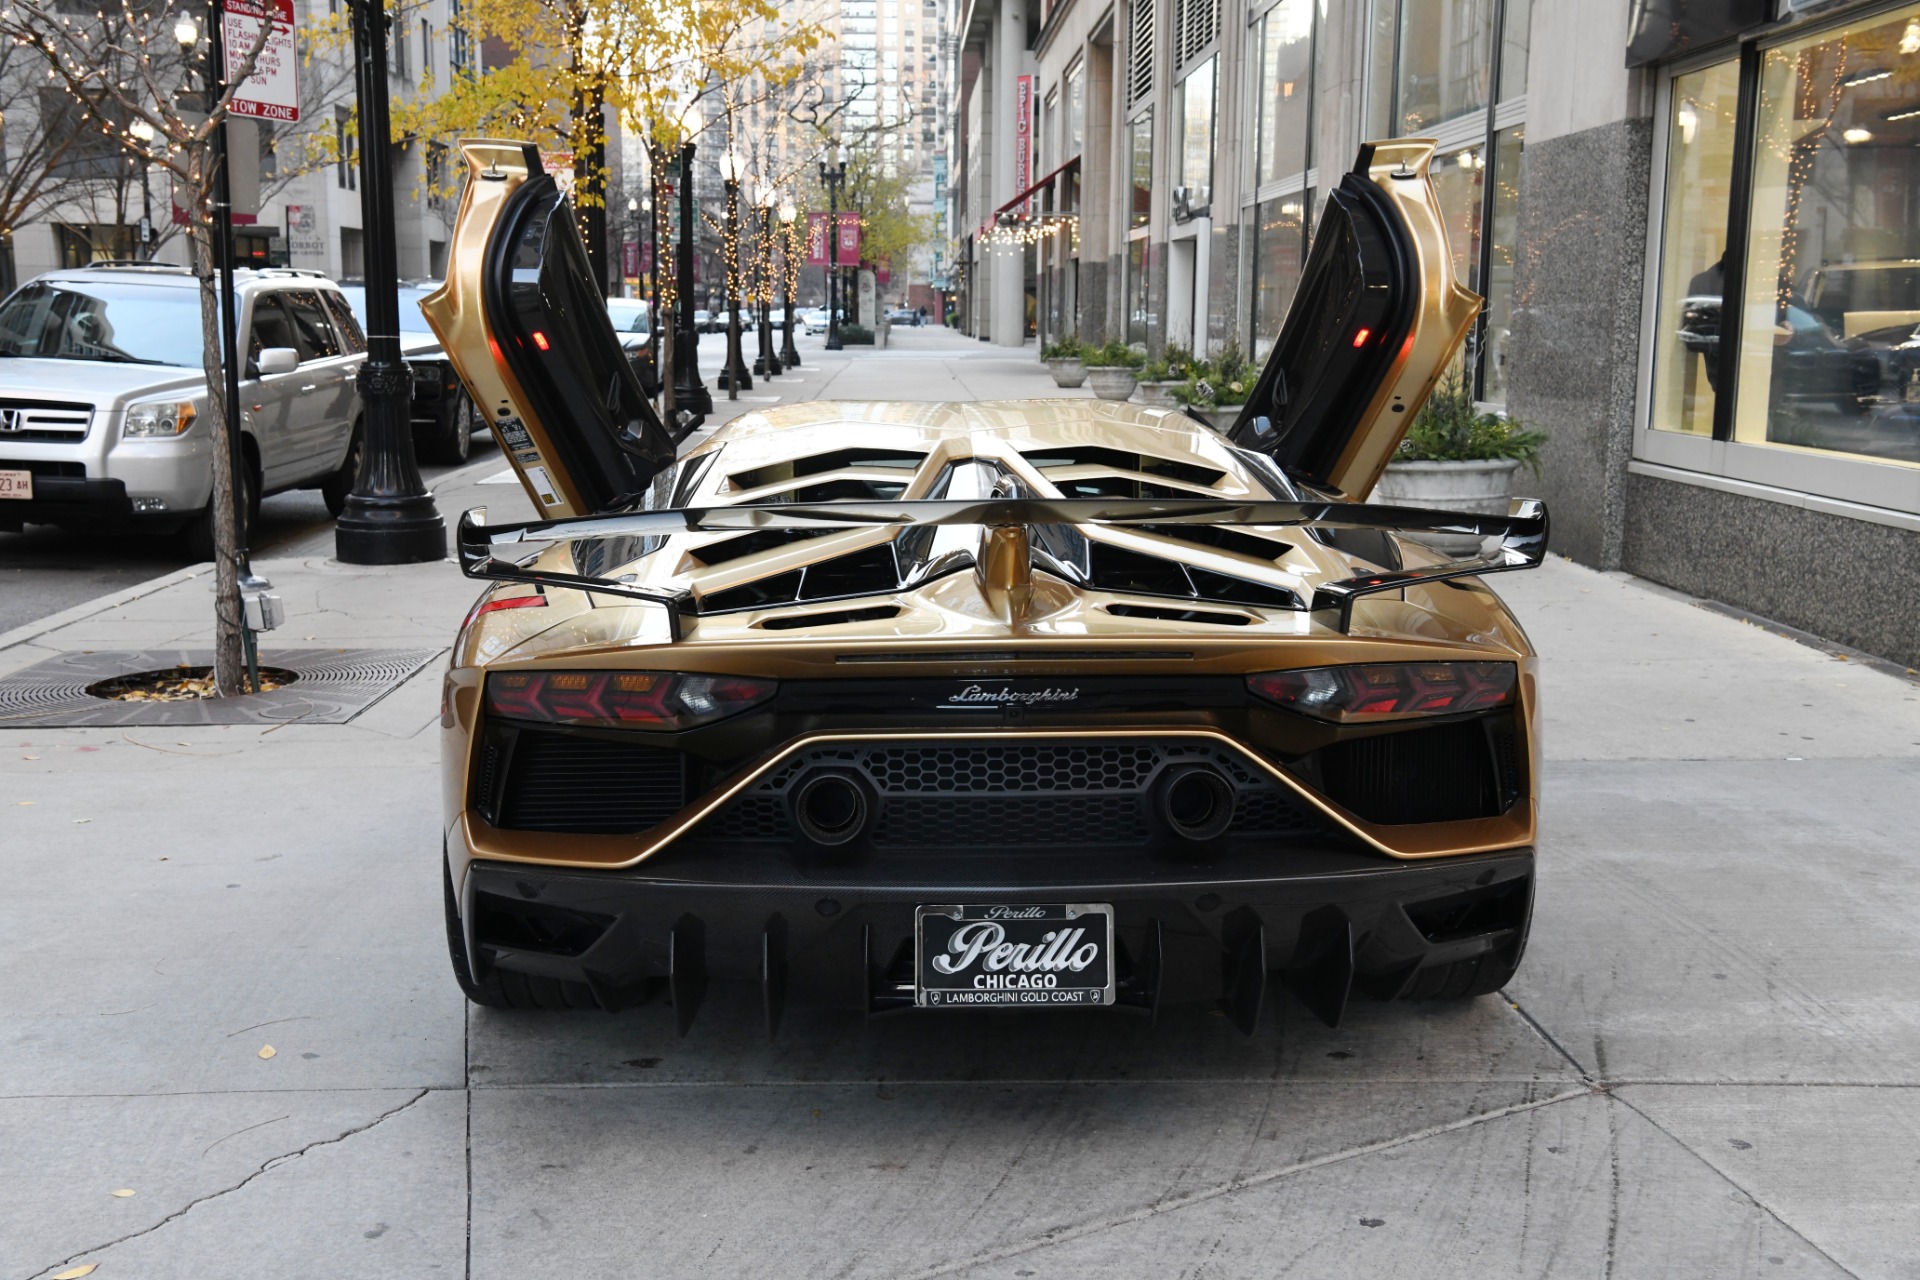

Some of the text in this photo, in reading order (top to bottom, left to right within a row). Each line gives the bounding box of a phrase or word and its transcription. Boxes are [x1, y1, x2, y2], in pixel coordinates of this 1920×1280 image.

[228, 17, 243, 28] USE
[228, 28, 260, 41] FLASHIN
[229, 40, 276, 55] 10 AM PM
[230, 60, 238, 70] 10
[265, 66, 276, 76] PM
[251, 76, 266, 86] SUN
[232, 100, 294, 120] TOW ZONE
[1017, 82, 1027, 133] EPIC
[949, 685, 1079, 705] Lamborghini
[984, 905, 1046, 919] Perillo
[932, 921, 1099, 974] Perillo
[973, 973, 1057, 989] CHICAGO
[946, 991, 1084, 1003] LAMBORGHINI GOLD COAST
